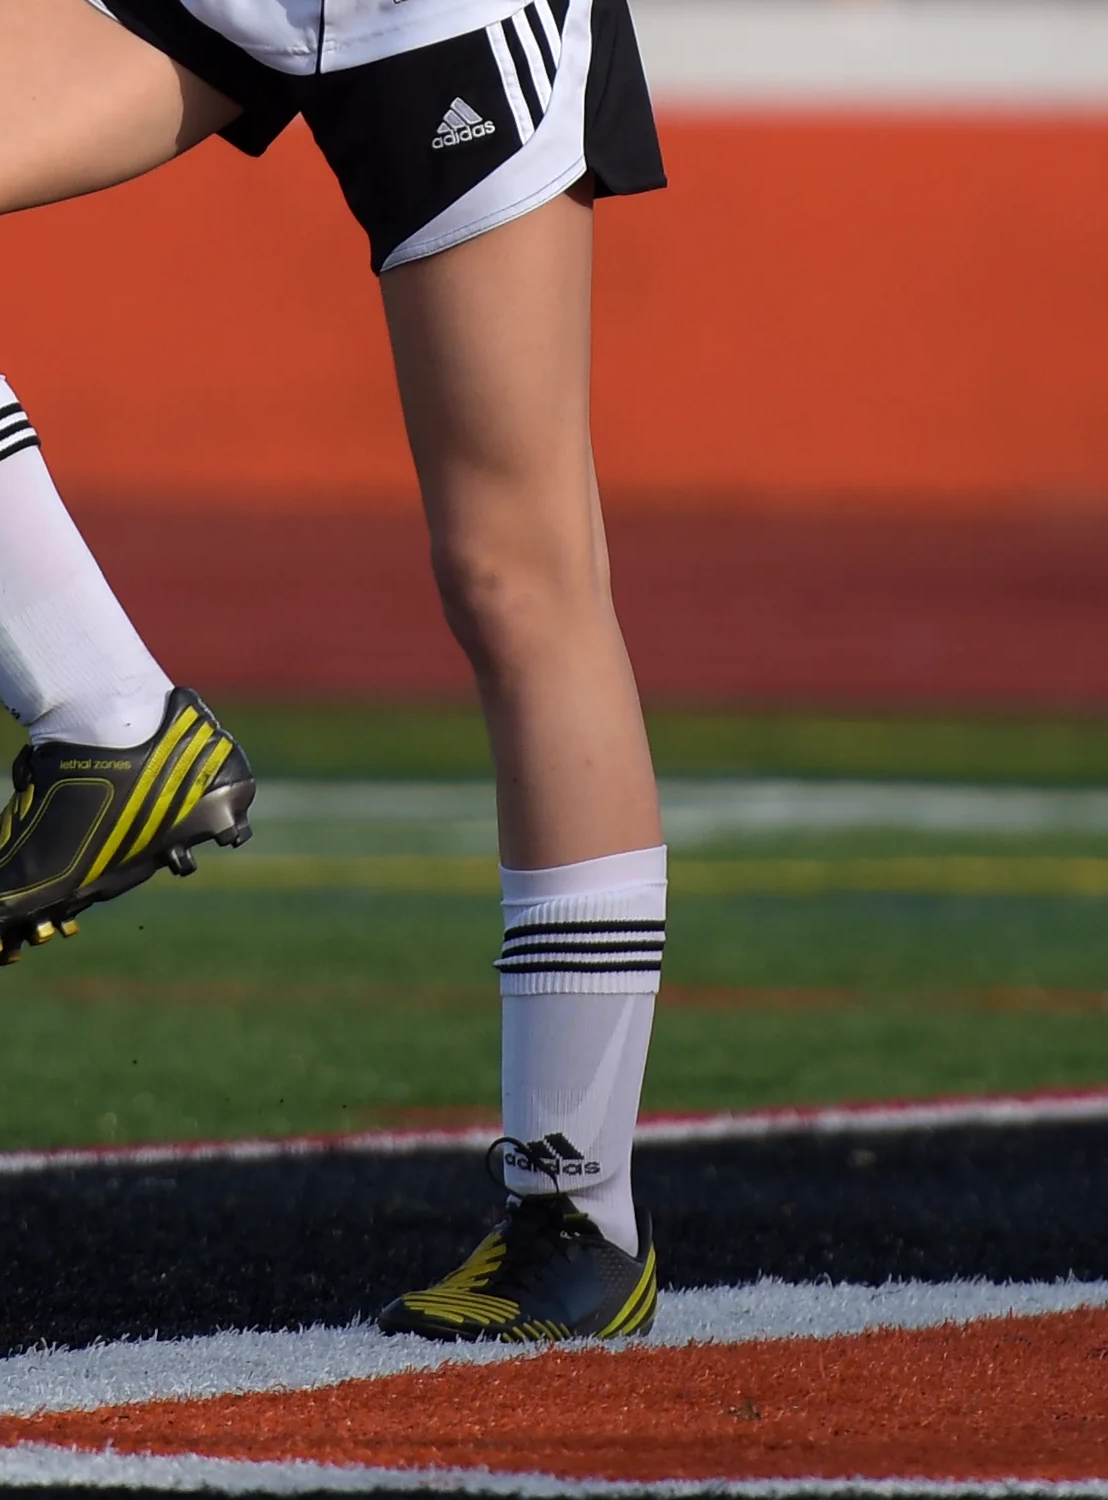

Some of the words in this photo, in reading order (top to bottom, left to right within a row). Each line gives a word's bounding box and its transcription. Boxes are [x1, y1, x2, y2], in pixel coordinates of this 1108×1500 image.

[431, 120, 496, 149] adidas
[59, 759, 92, 770] lethal
[93, 760, 132, 770] zones
